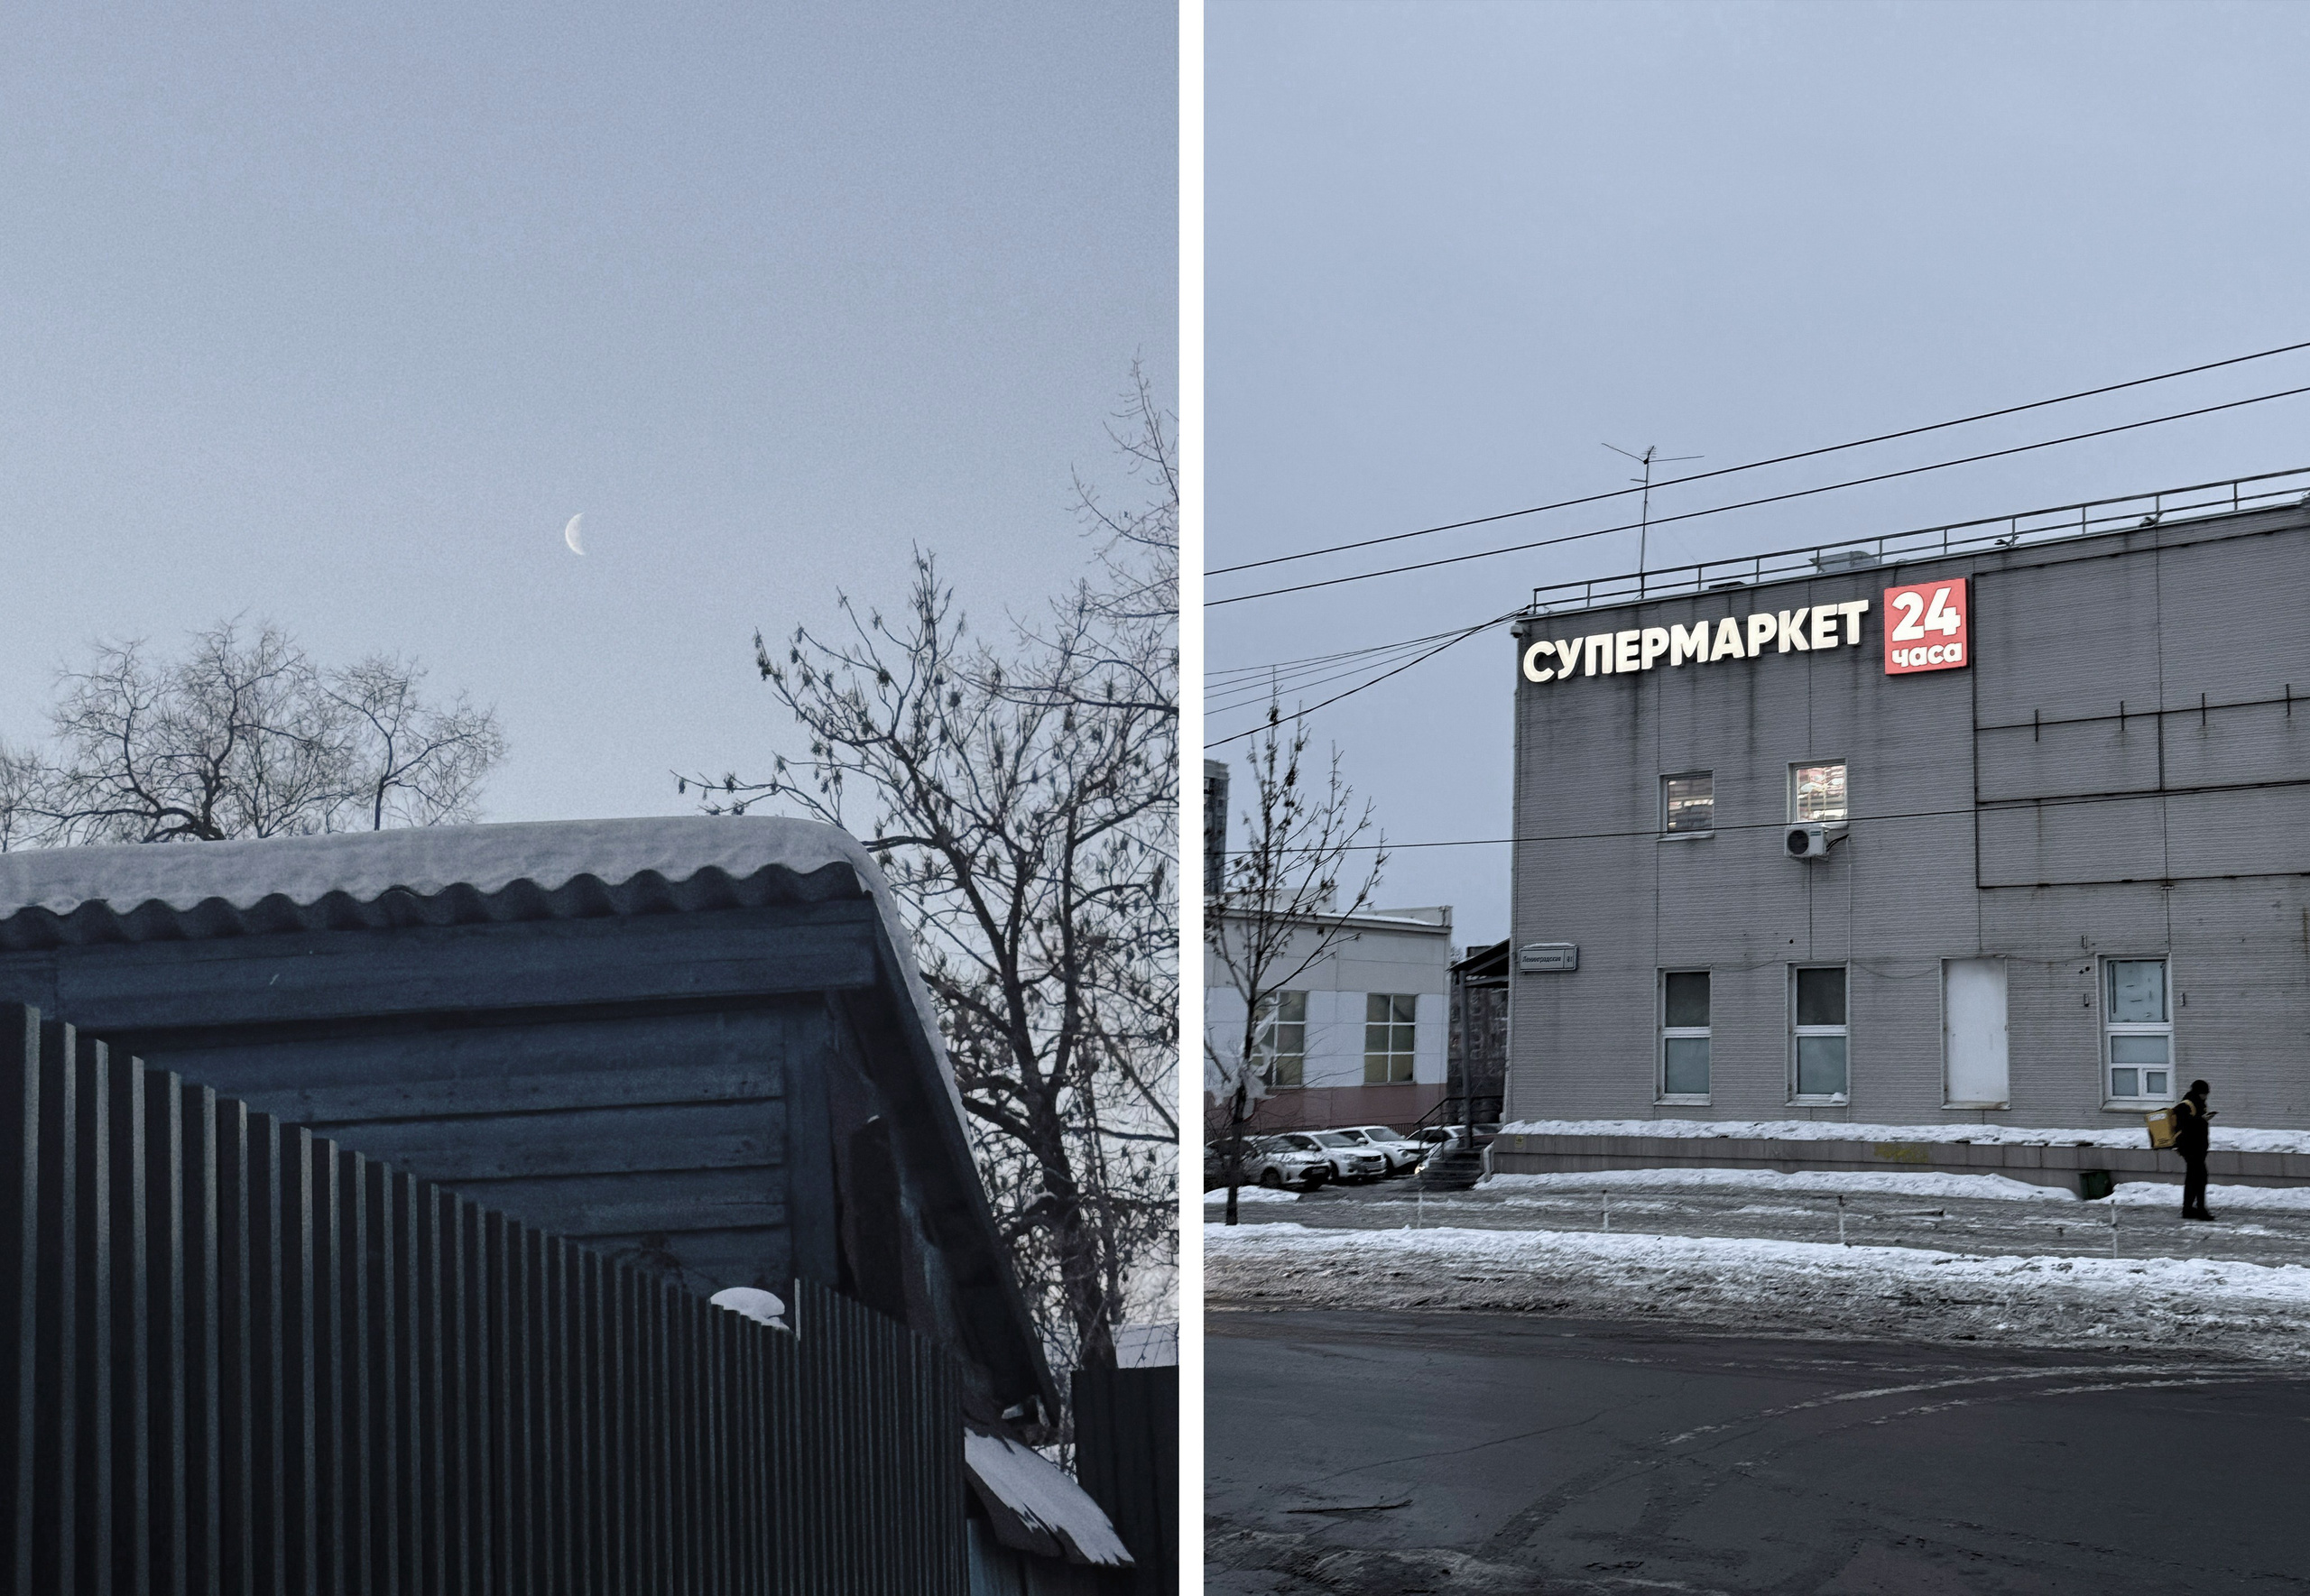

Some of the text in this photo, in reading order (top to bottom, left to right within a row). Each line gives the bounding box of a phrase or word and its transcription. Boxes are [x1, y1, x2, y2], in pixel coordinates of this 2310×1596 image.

[1891, 586, 1961, 641] 24
[1522, 599, 1870, 683] СУПЕРМАРКЕТ
[1891, 641, 1964, 668] часа
[1522, 955, 1561, 964] Ленинградская
